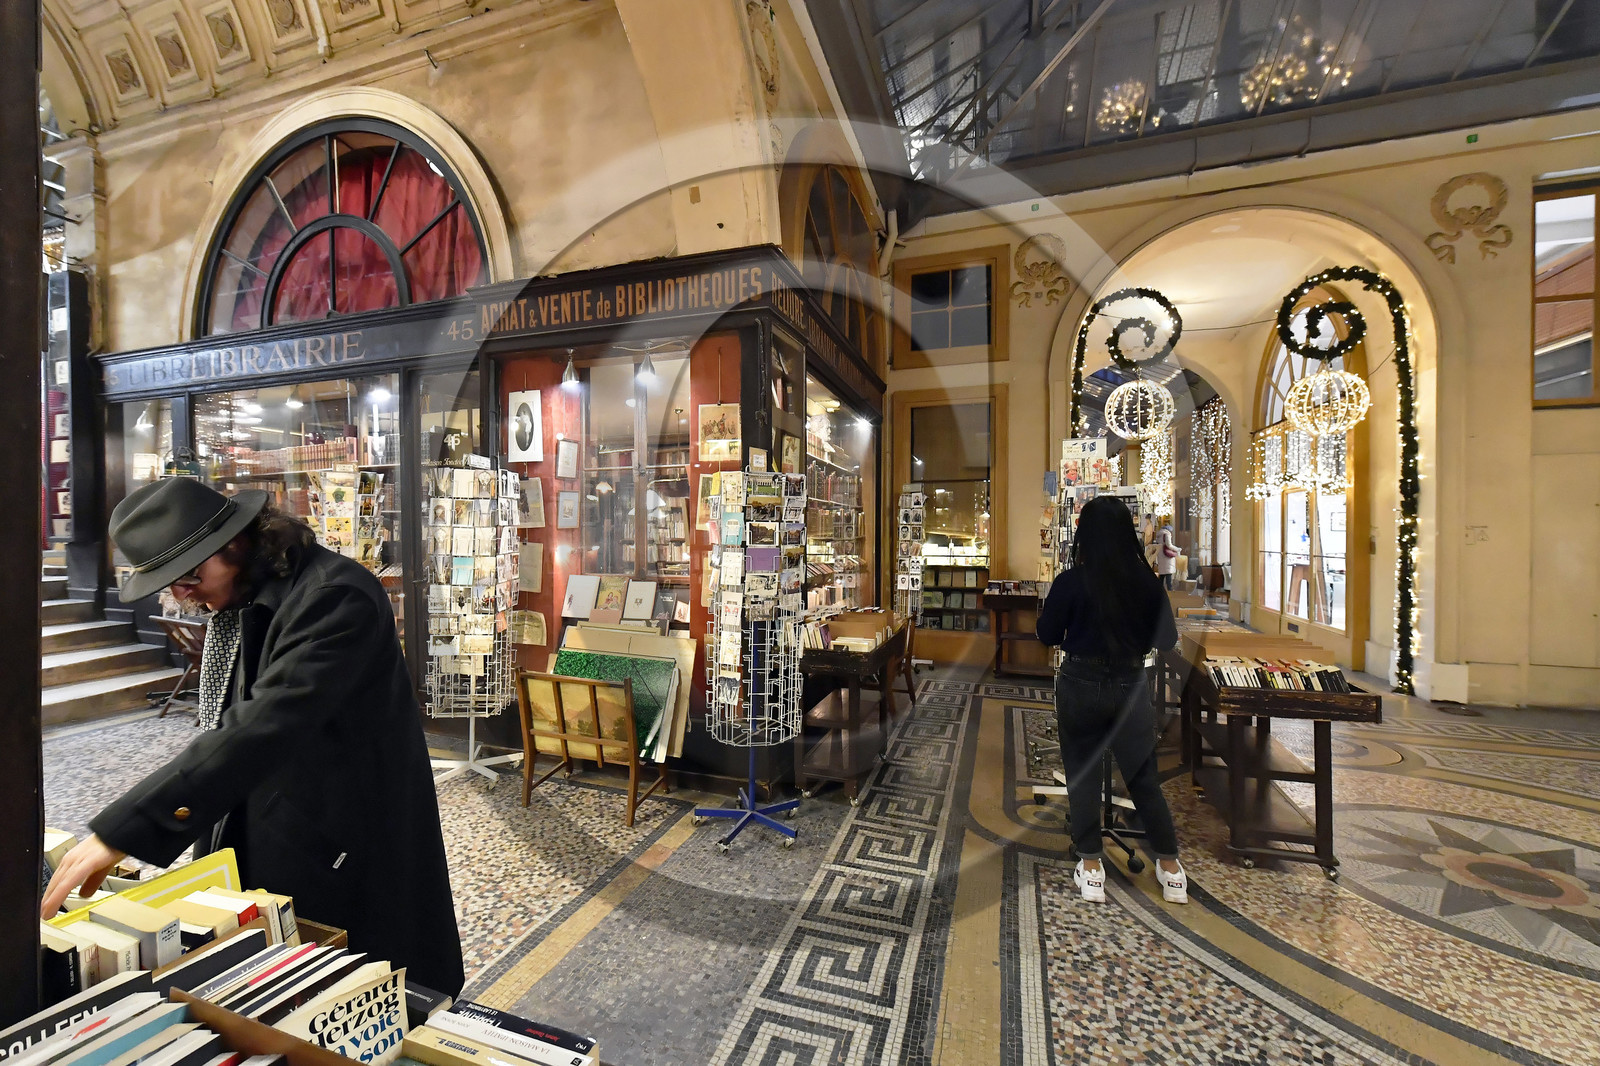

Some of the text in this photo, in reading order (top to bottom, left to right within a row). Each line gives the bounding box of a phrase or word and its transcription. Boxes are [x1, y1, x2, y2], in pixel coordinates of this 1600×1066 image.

[481, 266, 763, 335] ACHAT & VENTE de BIBLIOTHEQUES
[446, 318, 474, 342] 45
[190, 330, 366, 381] LIBRAIRIE
[308, 973, 399, 1035] Gérard
[348, 1010, 401, 1049] voie
[353, 1026, 404, 1065] son
